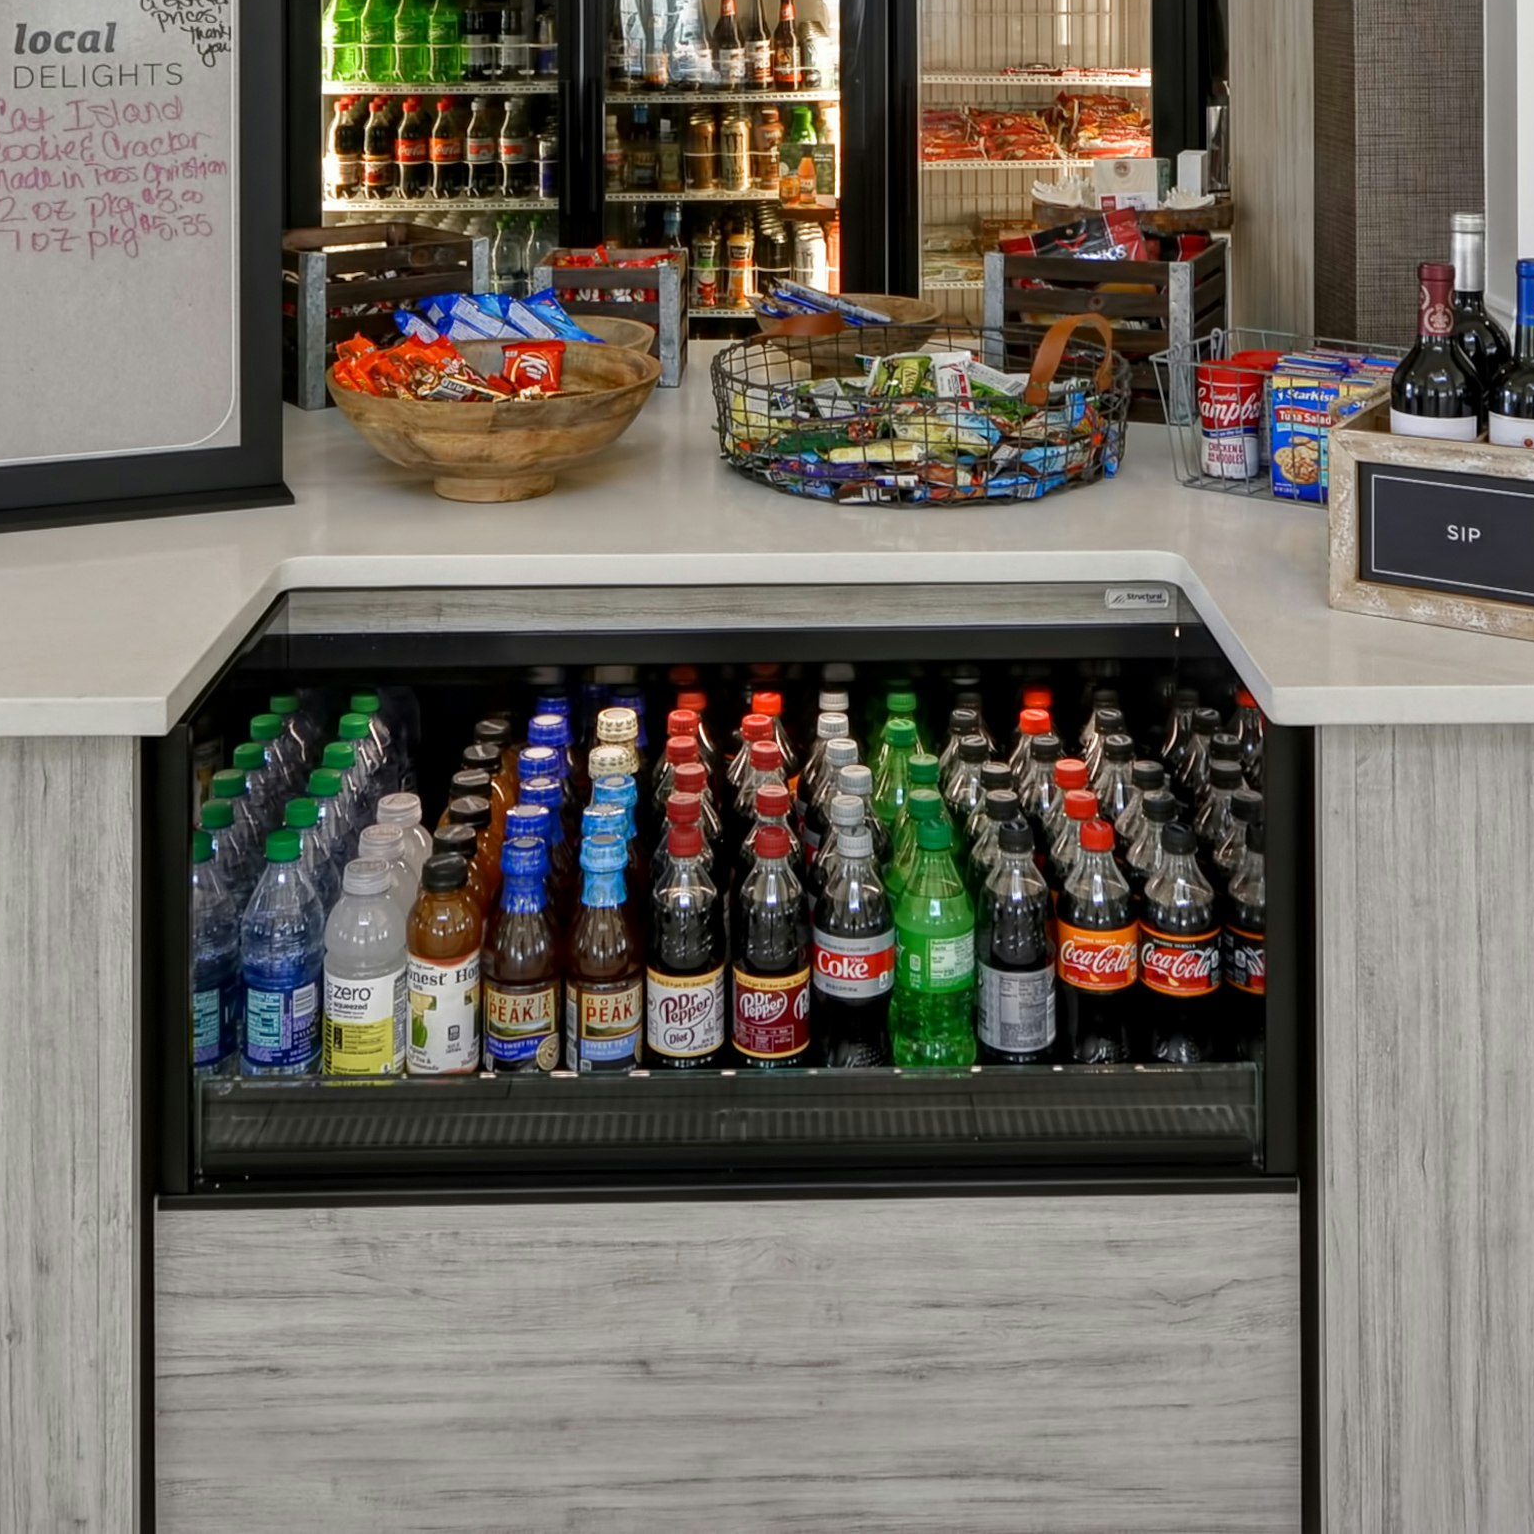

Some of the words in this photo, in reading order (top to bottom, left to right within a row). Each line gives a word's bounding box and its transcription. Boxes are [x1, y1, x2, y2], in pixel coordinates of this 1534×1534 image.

[14, 22, 116, 54] local
[14, 63, 183, 89] DELIGHTS
[63, 96, 183, 131] Island
[62, 166, 84, 189] in
[1286, 389, 1334, 402] StarKist
[1447, 525, 1481, 543] SIP
[818, 950, 869, 979] Coke
[1060, 939, 1133, 974] Coca-Cola
[1141, 942, 1213, 978] Coca-Cola
[334, 985, 371, 1001] zero
[586, 993, 633, 1007] GOLD
[679, 993, 699, 1010] Dr
[490, 1003, 534, 1023] PEAK
[586, 1003, 633, 1023] PEAK
[662, 996, 710, 1026] Pepper
[744, 993, 783, 1020] Pepper
[669, 1032, 688, 1045] Diet
